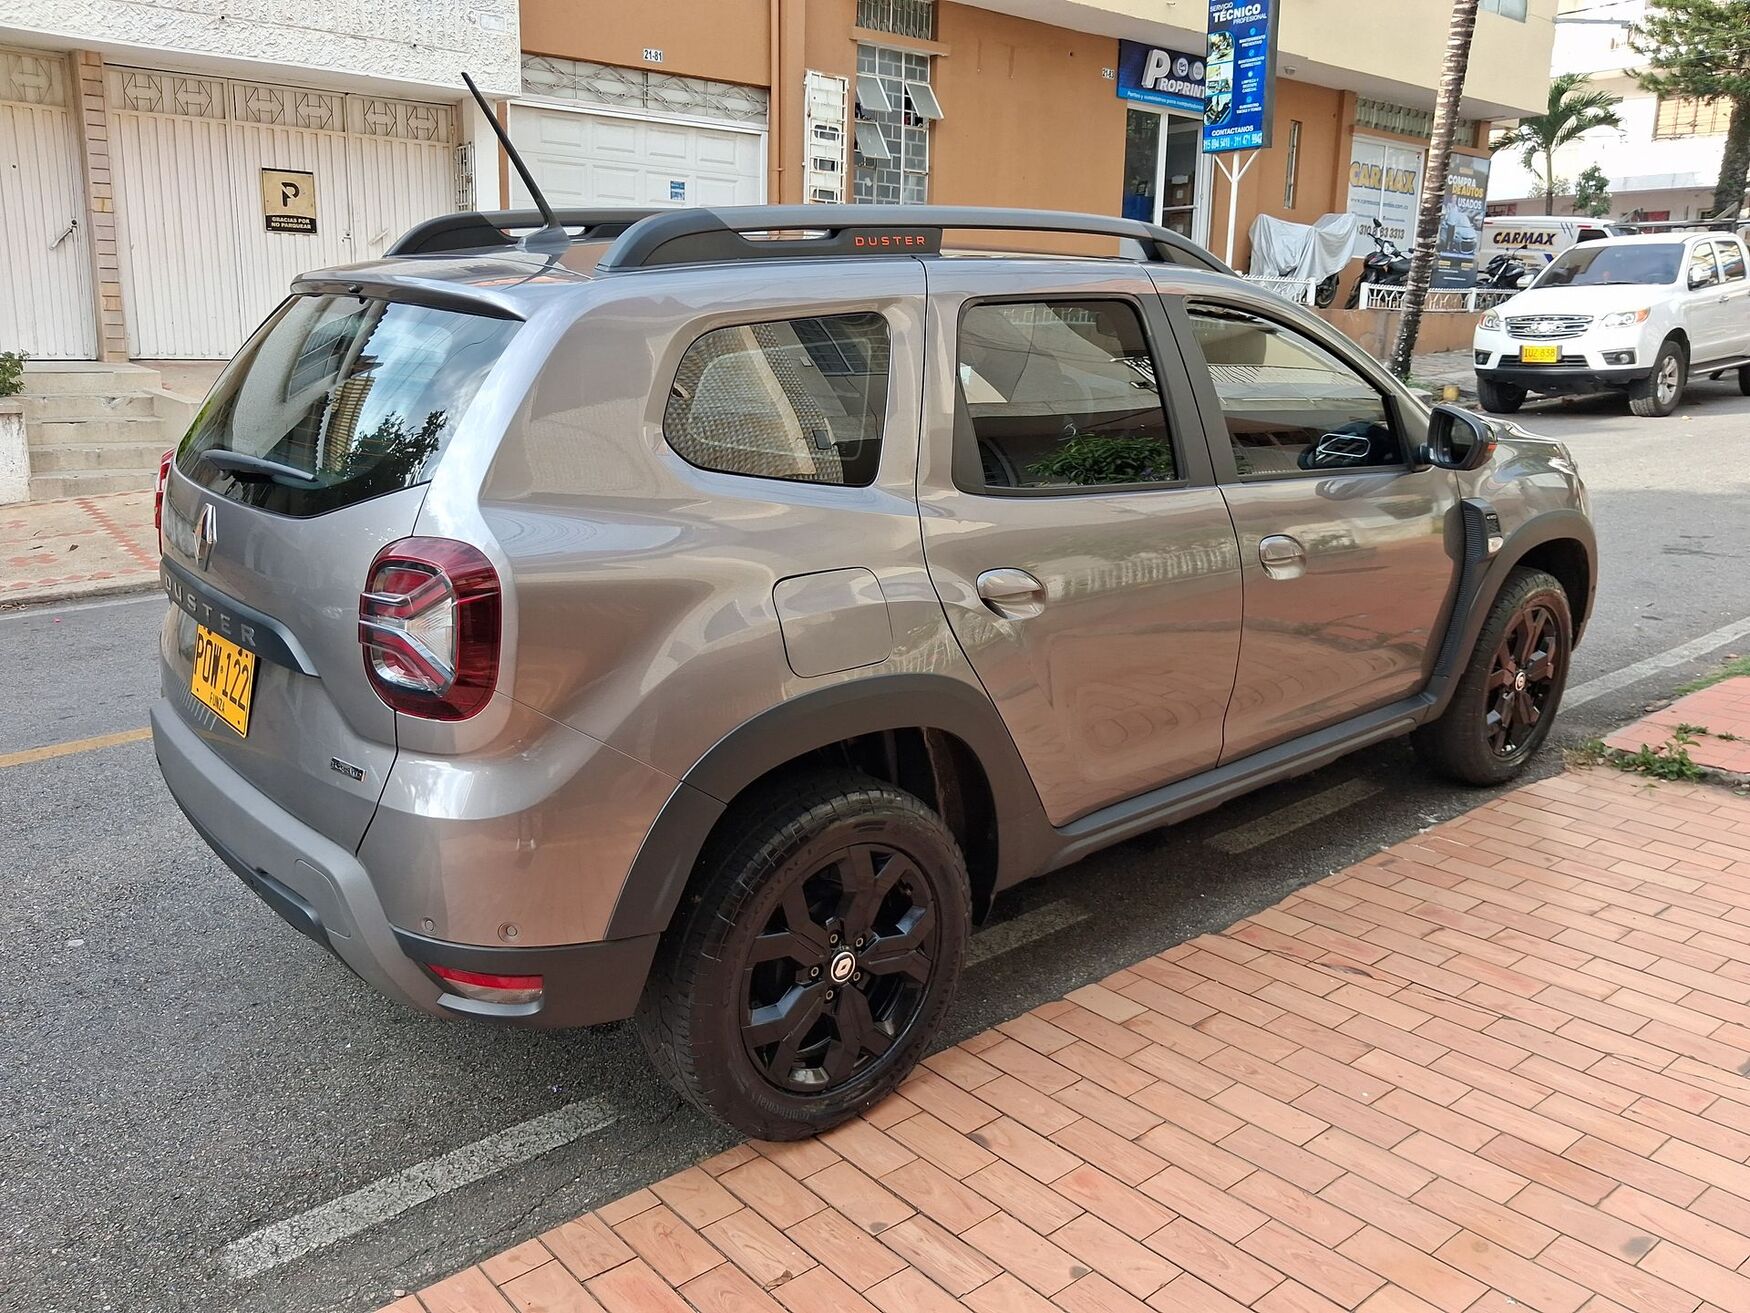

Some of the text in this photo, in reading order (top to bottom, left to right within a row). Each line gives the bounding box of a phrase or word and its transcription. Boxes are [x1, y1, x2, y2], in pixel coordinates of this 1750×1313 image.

[1213, 3, 1261, 23] TÉCNICO
[644, 49, 662, 62] 21-81
[1349, 161, 1416, 195] CARMAX
[1447, 175, 1476, 187] COMPRA
[1457, 198, 1482, 210] USADOS
[855, 236, 926, 246] DUSTER
[1493, 231, 1557, 246] CARMAX
[164, 575, 257, 648] DUSTER
